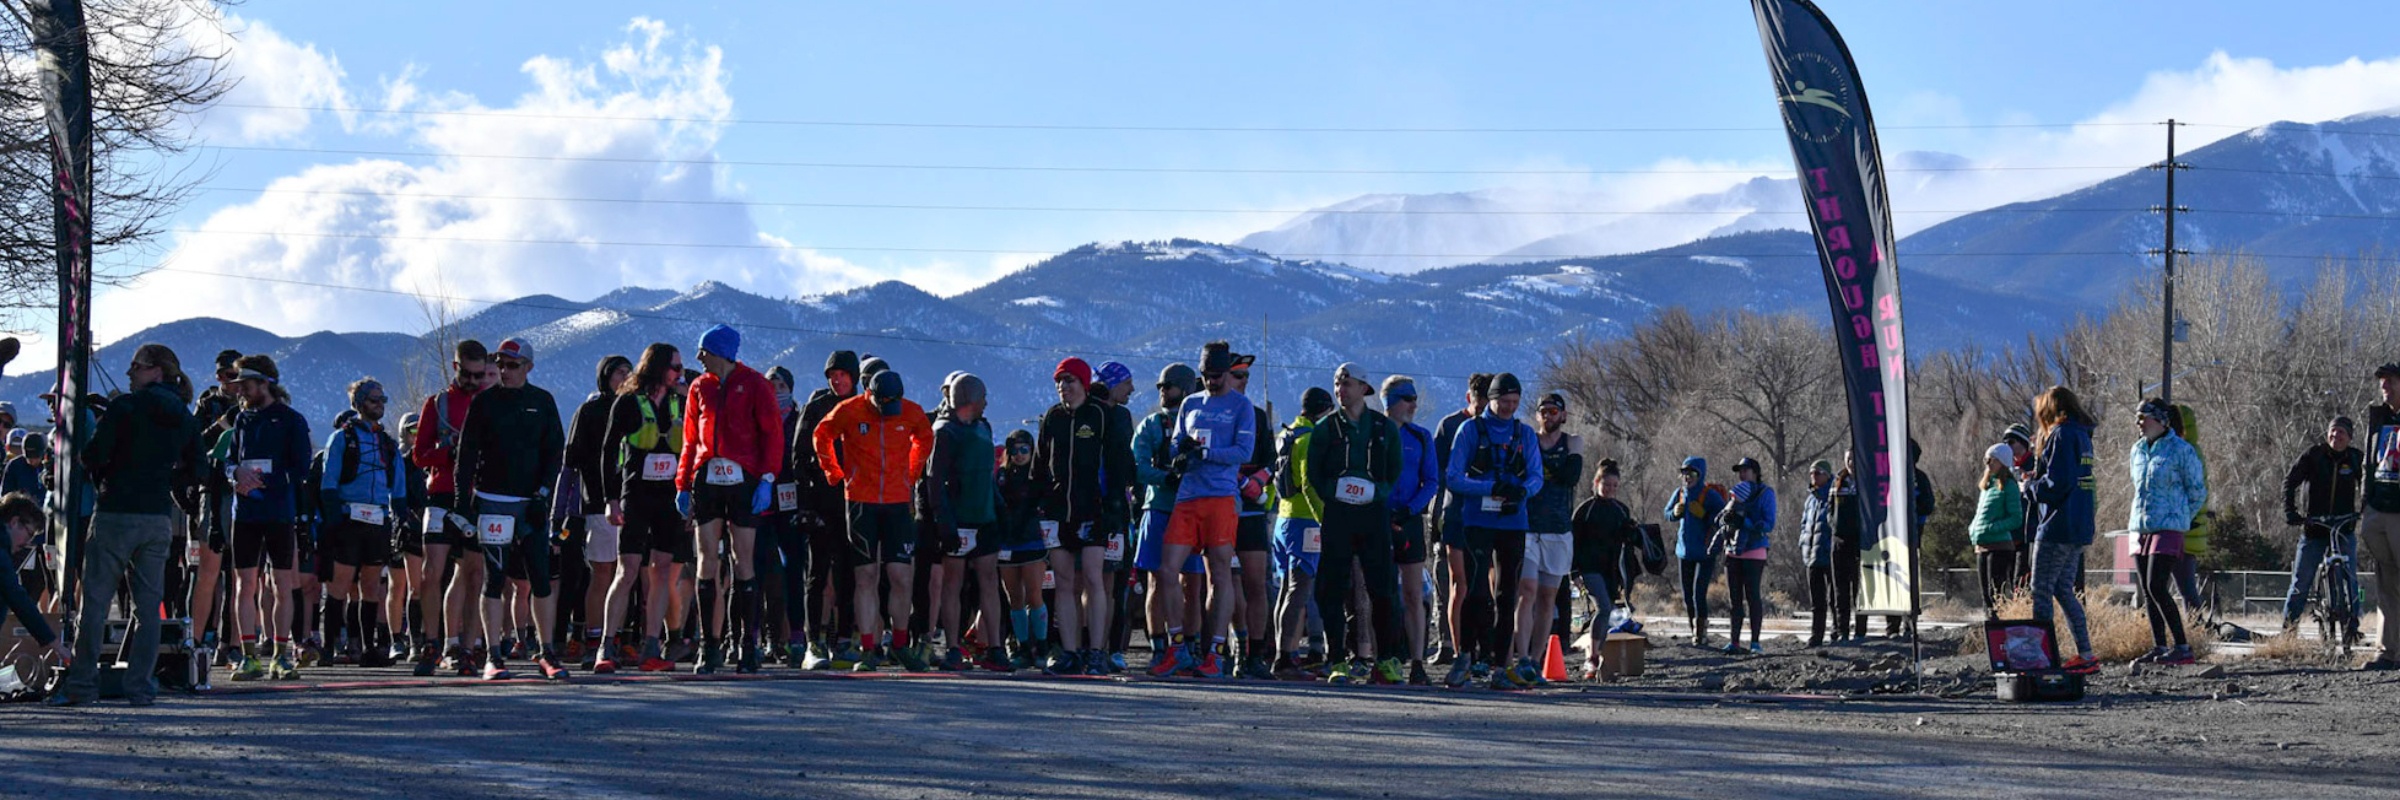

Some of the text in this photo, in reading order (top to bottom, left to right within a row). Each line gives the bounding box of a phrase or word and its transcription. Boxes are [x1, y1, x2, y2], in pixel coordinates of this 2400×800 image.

[715, 466, 733, 476] 216
[1345, 484, 1364, 497] 201
[780, 491, 795, 502] 191
[488, 523, 502, 534] 44
